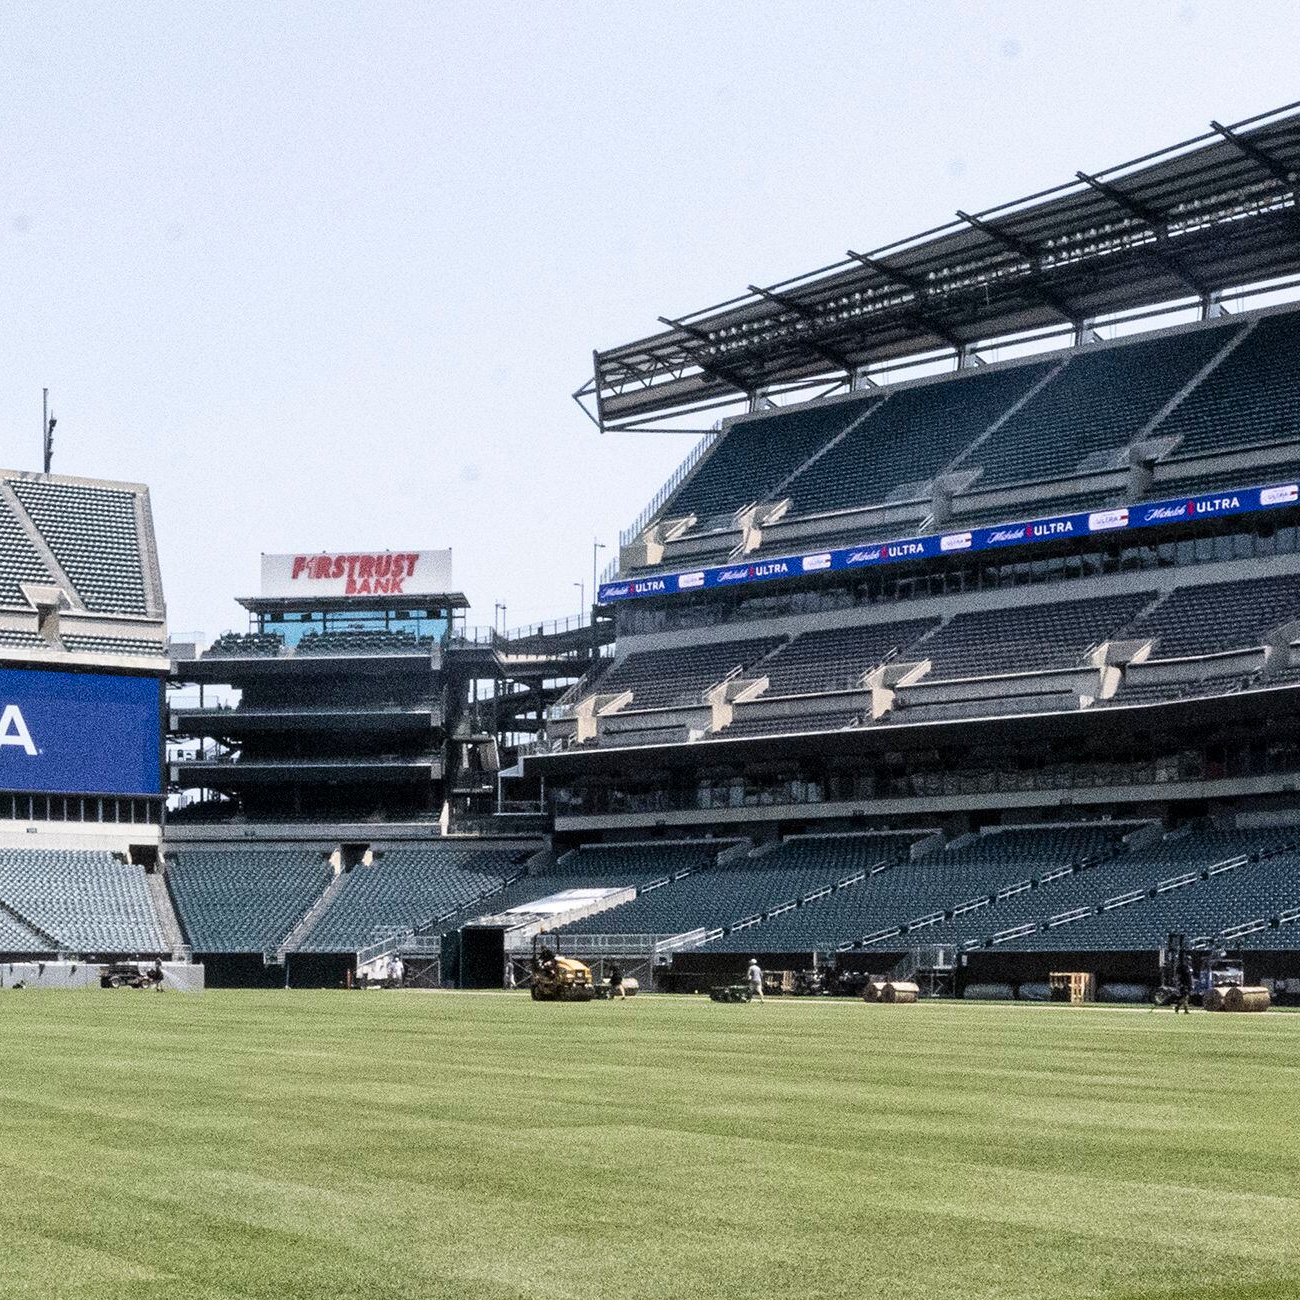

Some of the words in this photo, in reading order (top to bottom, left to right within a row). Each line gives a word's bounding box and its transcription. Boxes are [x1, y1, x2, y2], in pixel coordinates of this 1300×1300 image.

[1196, 497, 1240, 513] ULTRA
[1033, 521, 1074, 536] ULTRA
[888, 543, 925, 557] ULTRA
[755, 563, 789, 576] ULTRA
[345, 577, 406, 595] BANK
[635, 580, 666, 593] ULTRA
